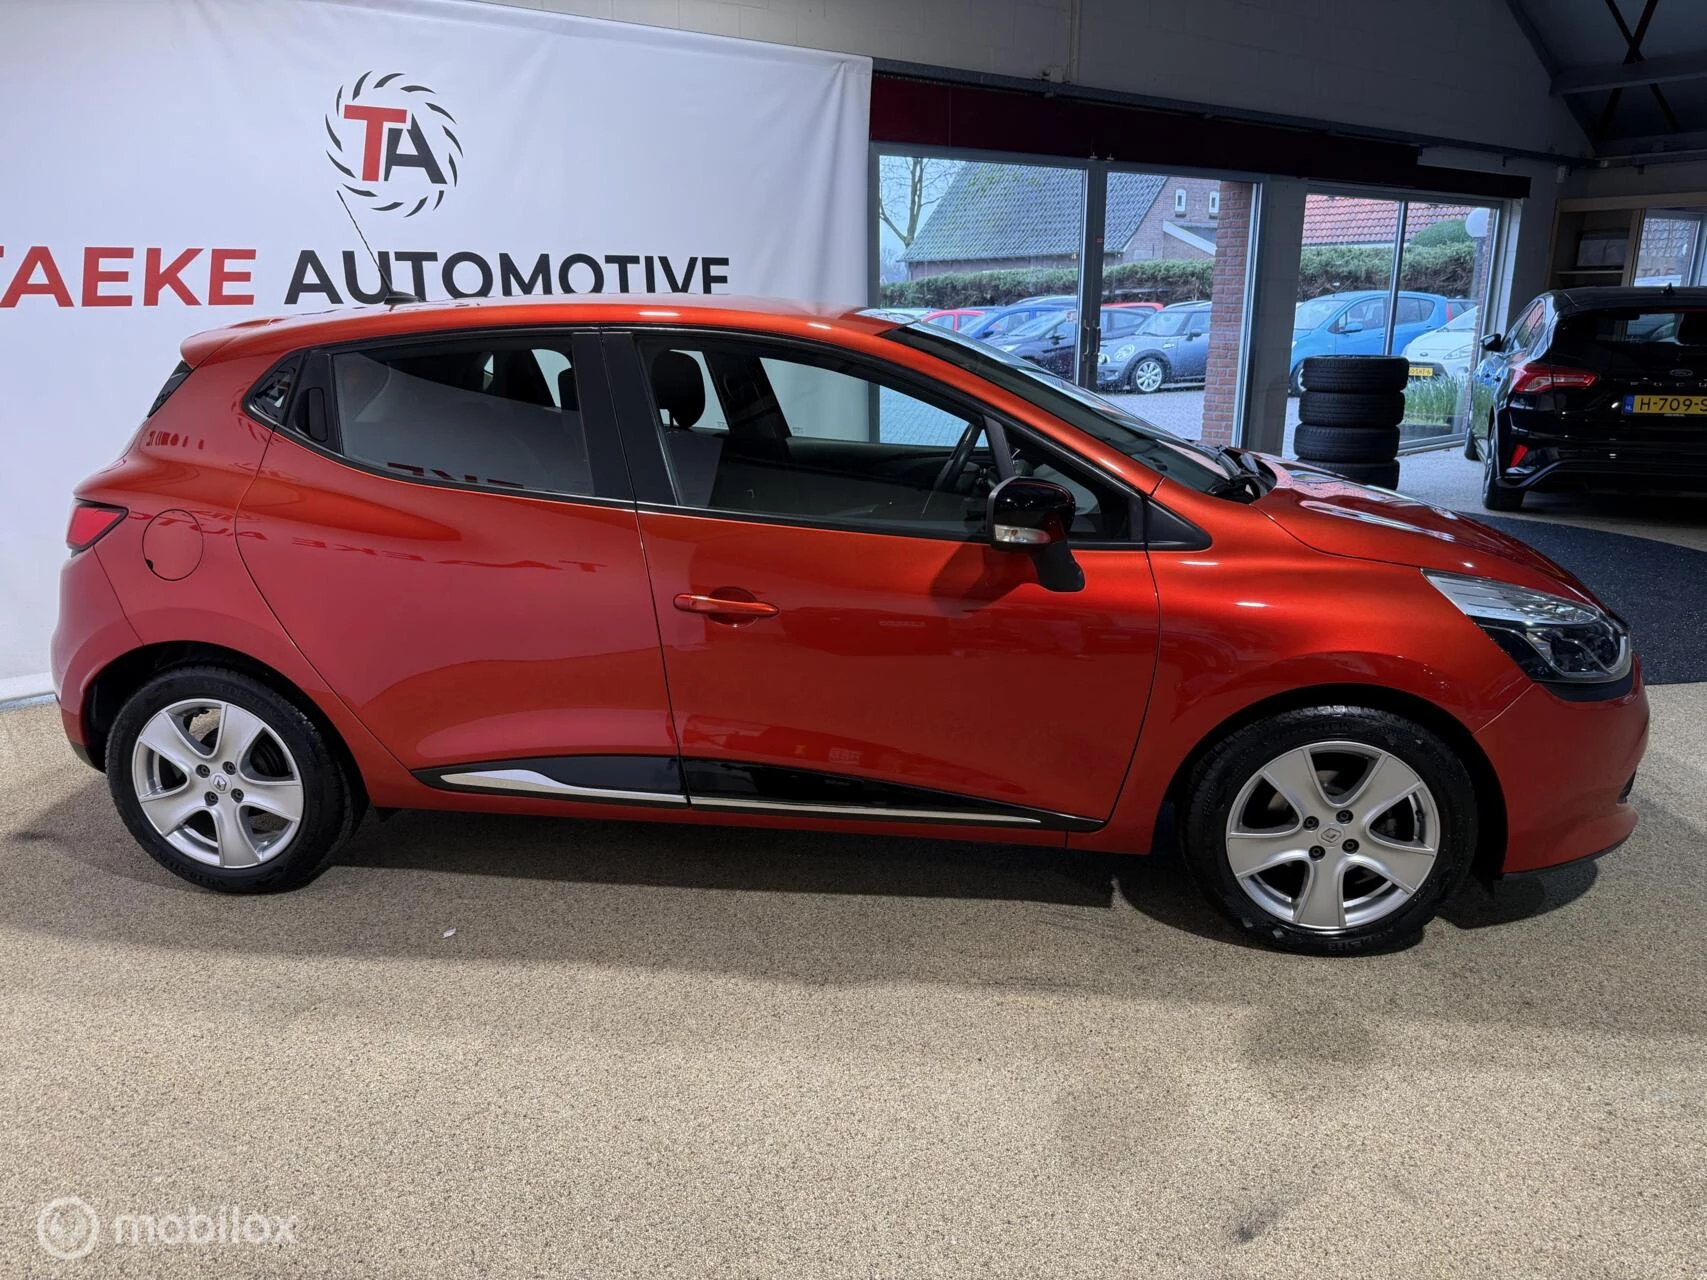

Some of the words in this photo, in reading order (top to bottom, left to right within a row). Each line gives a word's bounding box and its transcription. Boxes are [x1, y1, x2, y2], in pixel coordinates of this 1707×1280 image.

[344, 104, 447, 184] TA
[0, 246, 257, 308] AEKE
[284, 249, 730, 305] AUTOMOTIVE
